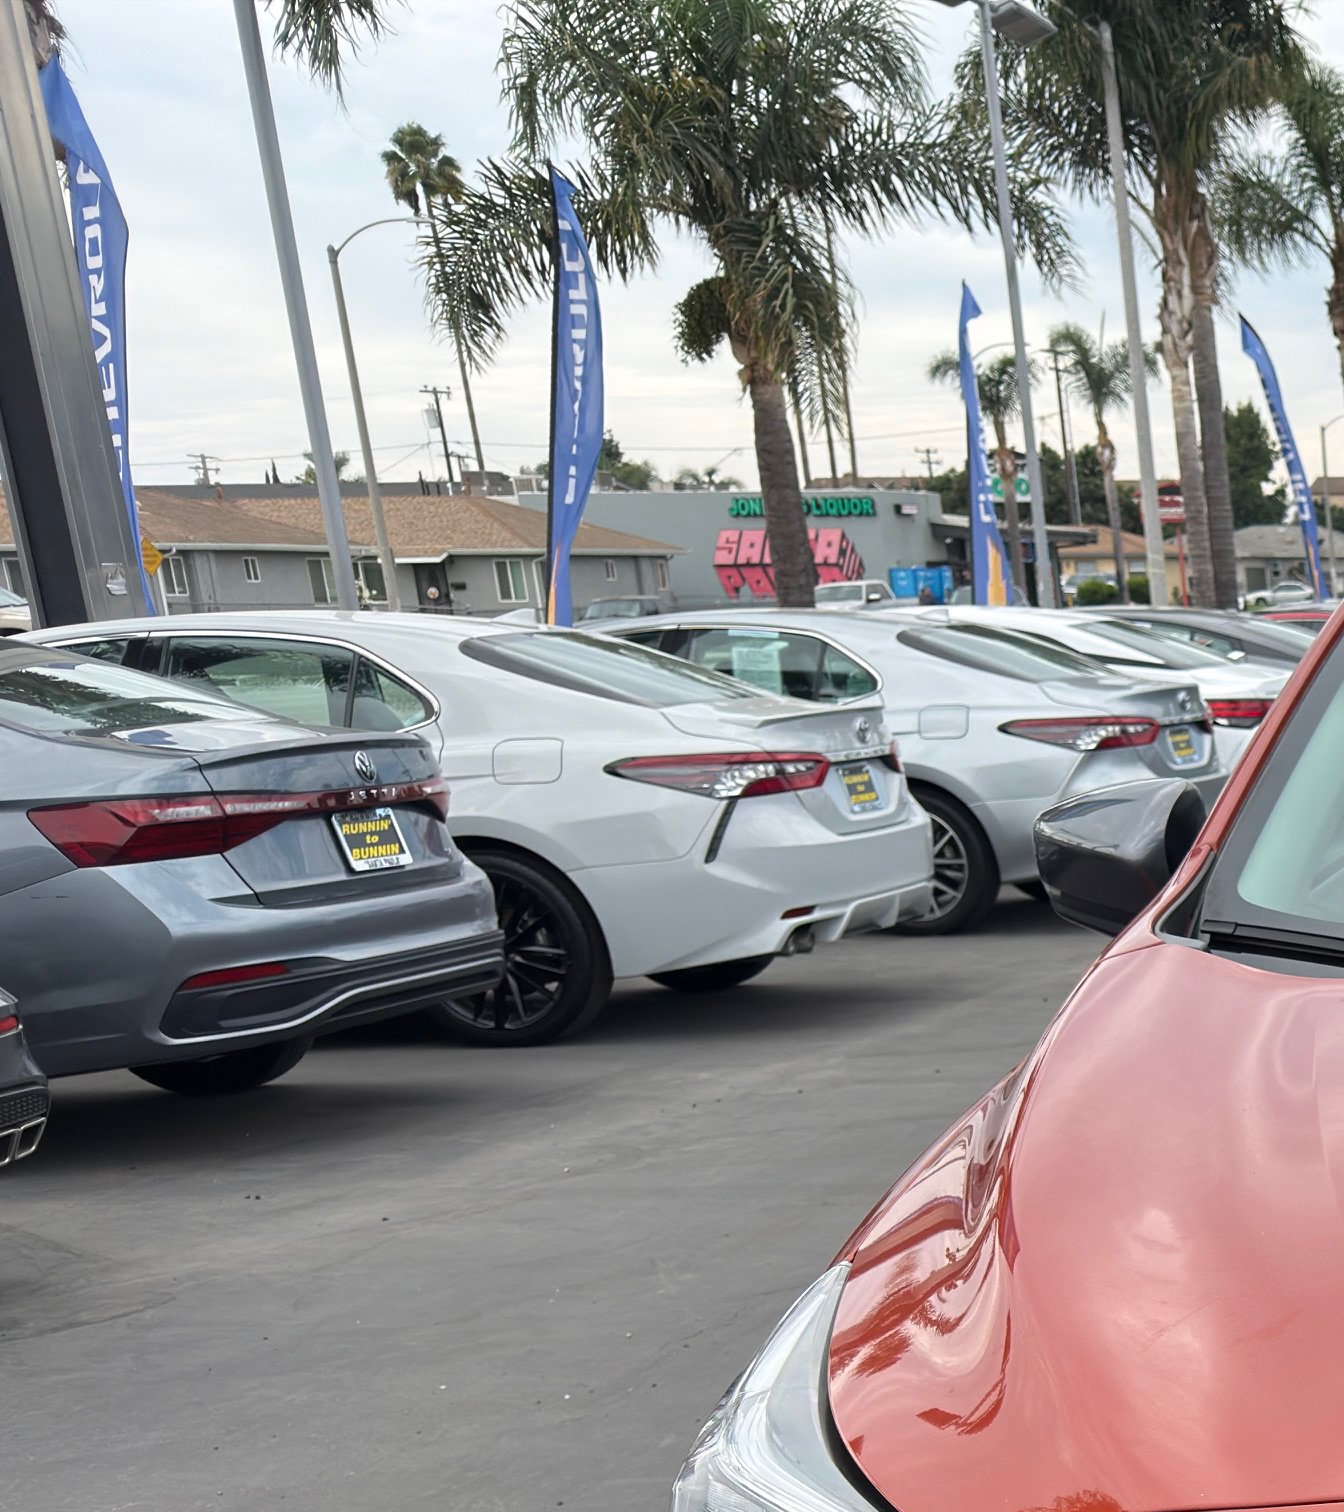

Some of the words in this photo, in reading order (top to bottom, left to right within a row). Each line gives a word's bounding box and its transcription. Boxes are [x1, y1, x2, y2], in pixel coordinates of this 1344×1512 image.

[811, 498, 875, 516] LIQUOR
[342, 819, 392, 836] RUNNIN'
[365, 834, 380, 844] to
[352, 843, 400, 860] BUNNIN
